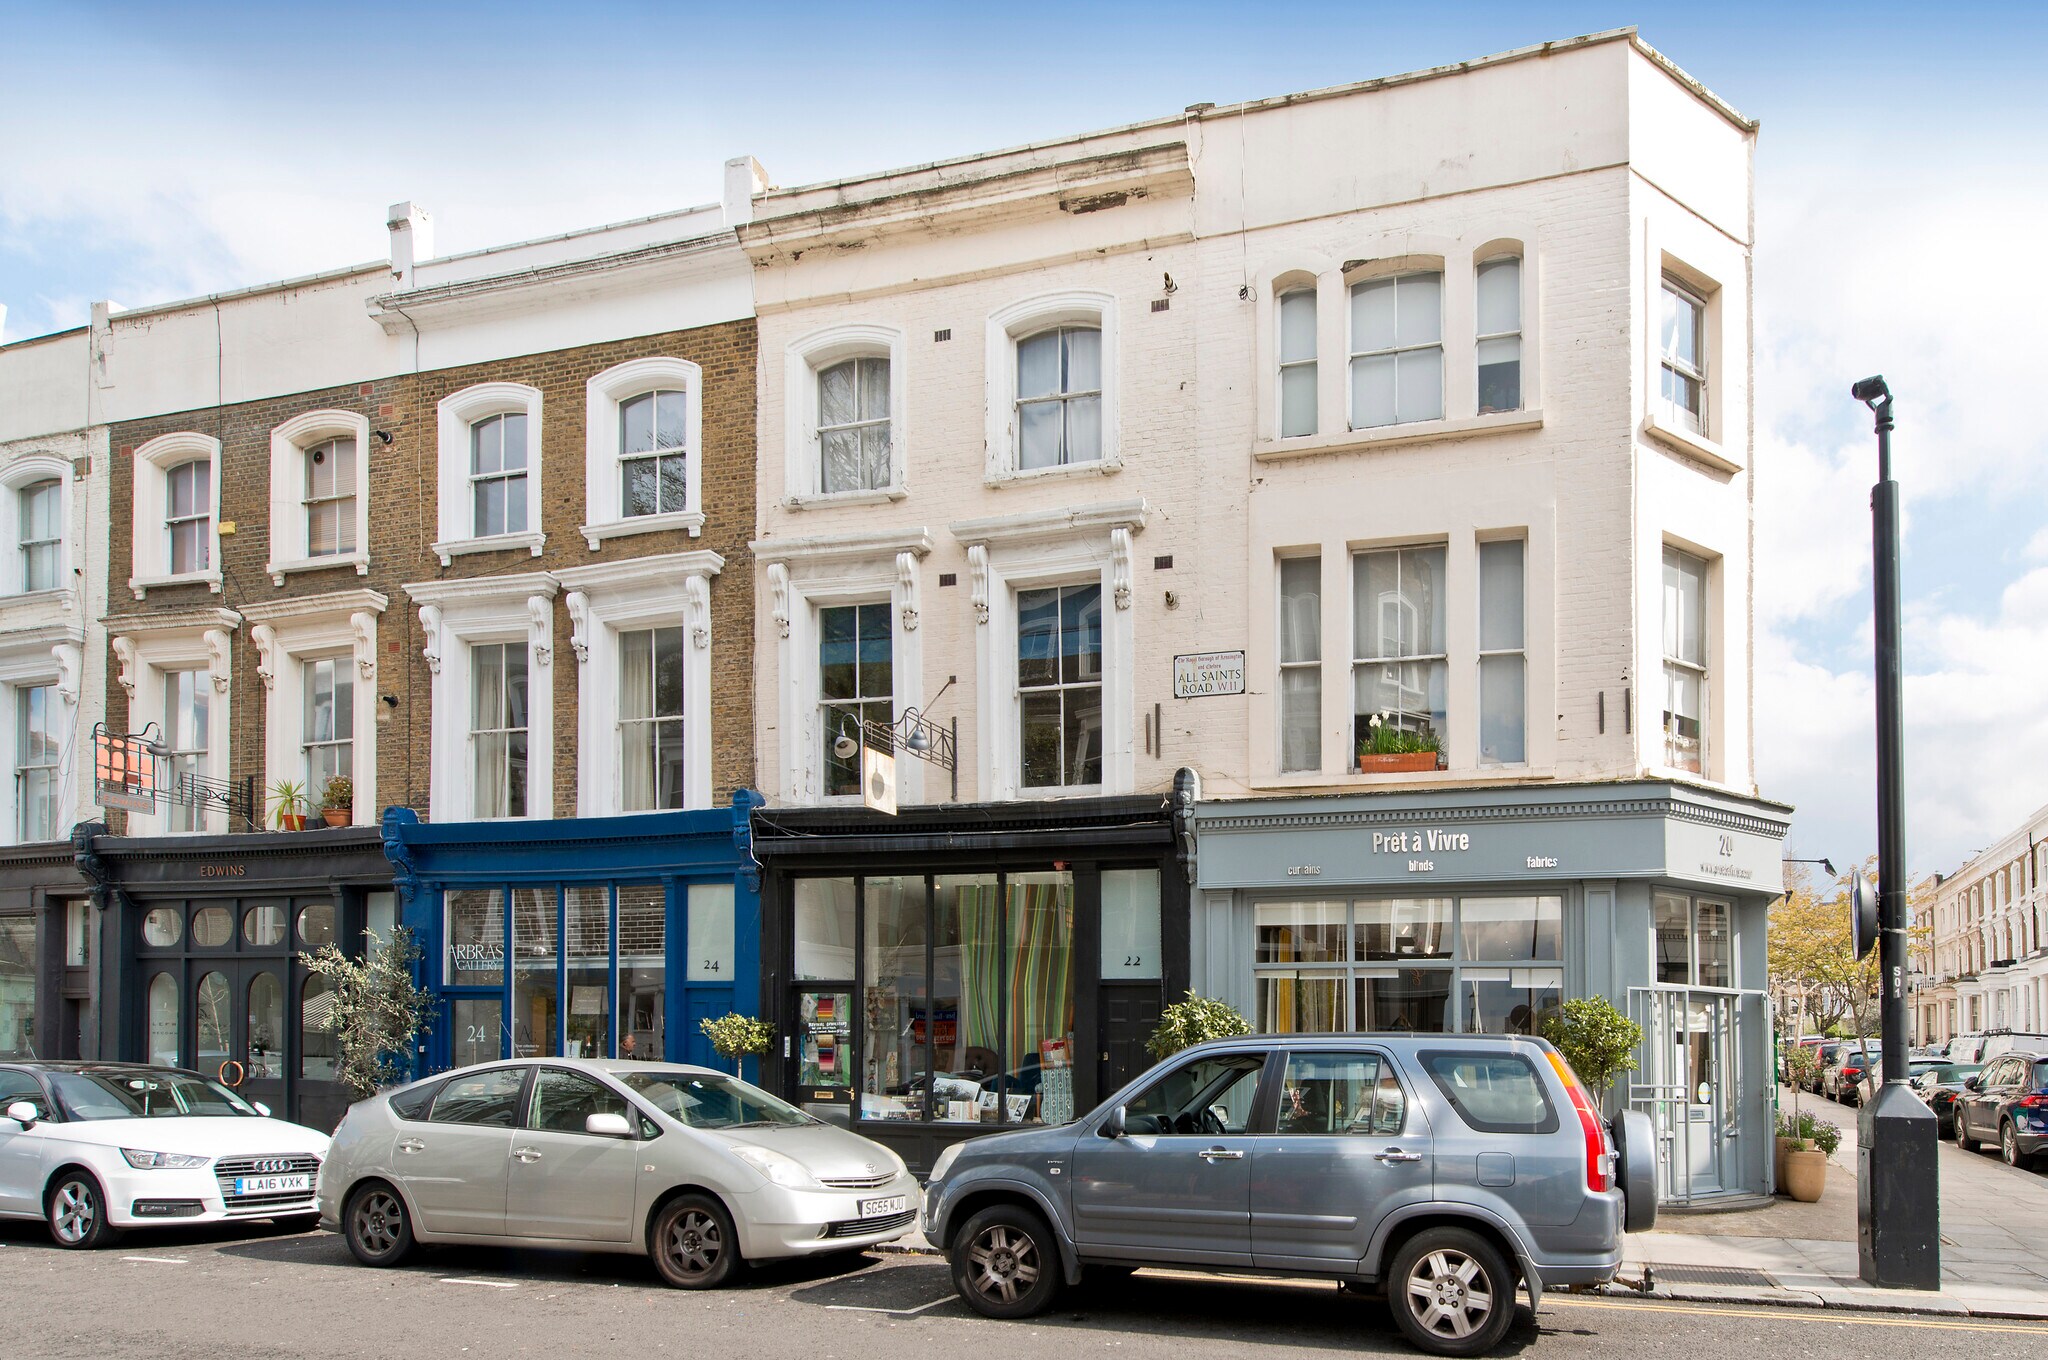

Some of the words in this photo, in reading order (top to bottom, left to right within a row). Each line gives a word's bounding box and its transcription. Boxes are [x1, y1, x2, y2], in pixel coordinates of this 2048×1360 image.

[1178, 672, 1198, 683] ALL
[1202, 669, 1240, 682] SAINTS
[104, 795, 148, 809] EDWINS
[1372, 832, 1408, 853] Prêt
[1412, 832, 1422, 852] à
[1426, 829, 1470, 851] Vivre
[1408, 860, 1434, 872] blinds
[1526, 856, 1558, 869] fabrics
[200, 864, 245, 876] EDWINS
[448, 944, 504, 961] ARBRAS
[456, 960, 498, 970] GALLERY
[704, 960, 720, 972] 24
[1124, 956, 1140, 966] 22
[466, 1025, 486, 1042] 24
[248, 1178, 277, 1191] LA16
[280, 1176, 304, 1188] VXK
[866, 1200, 888, 1214] SG55
